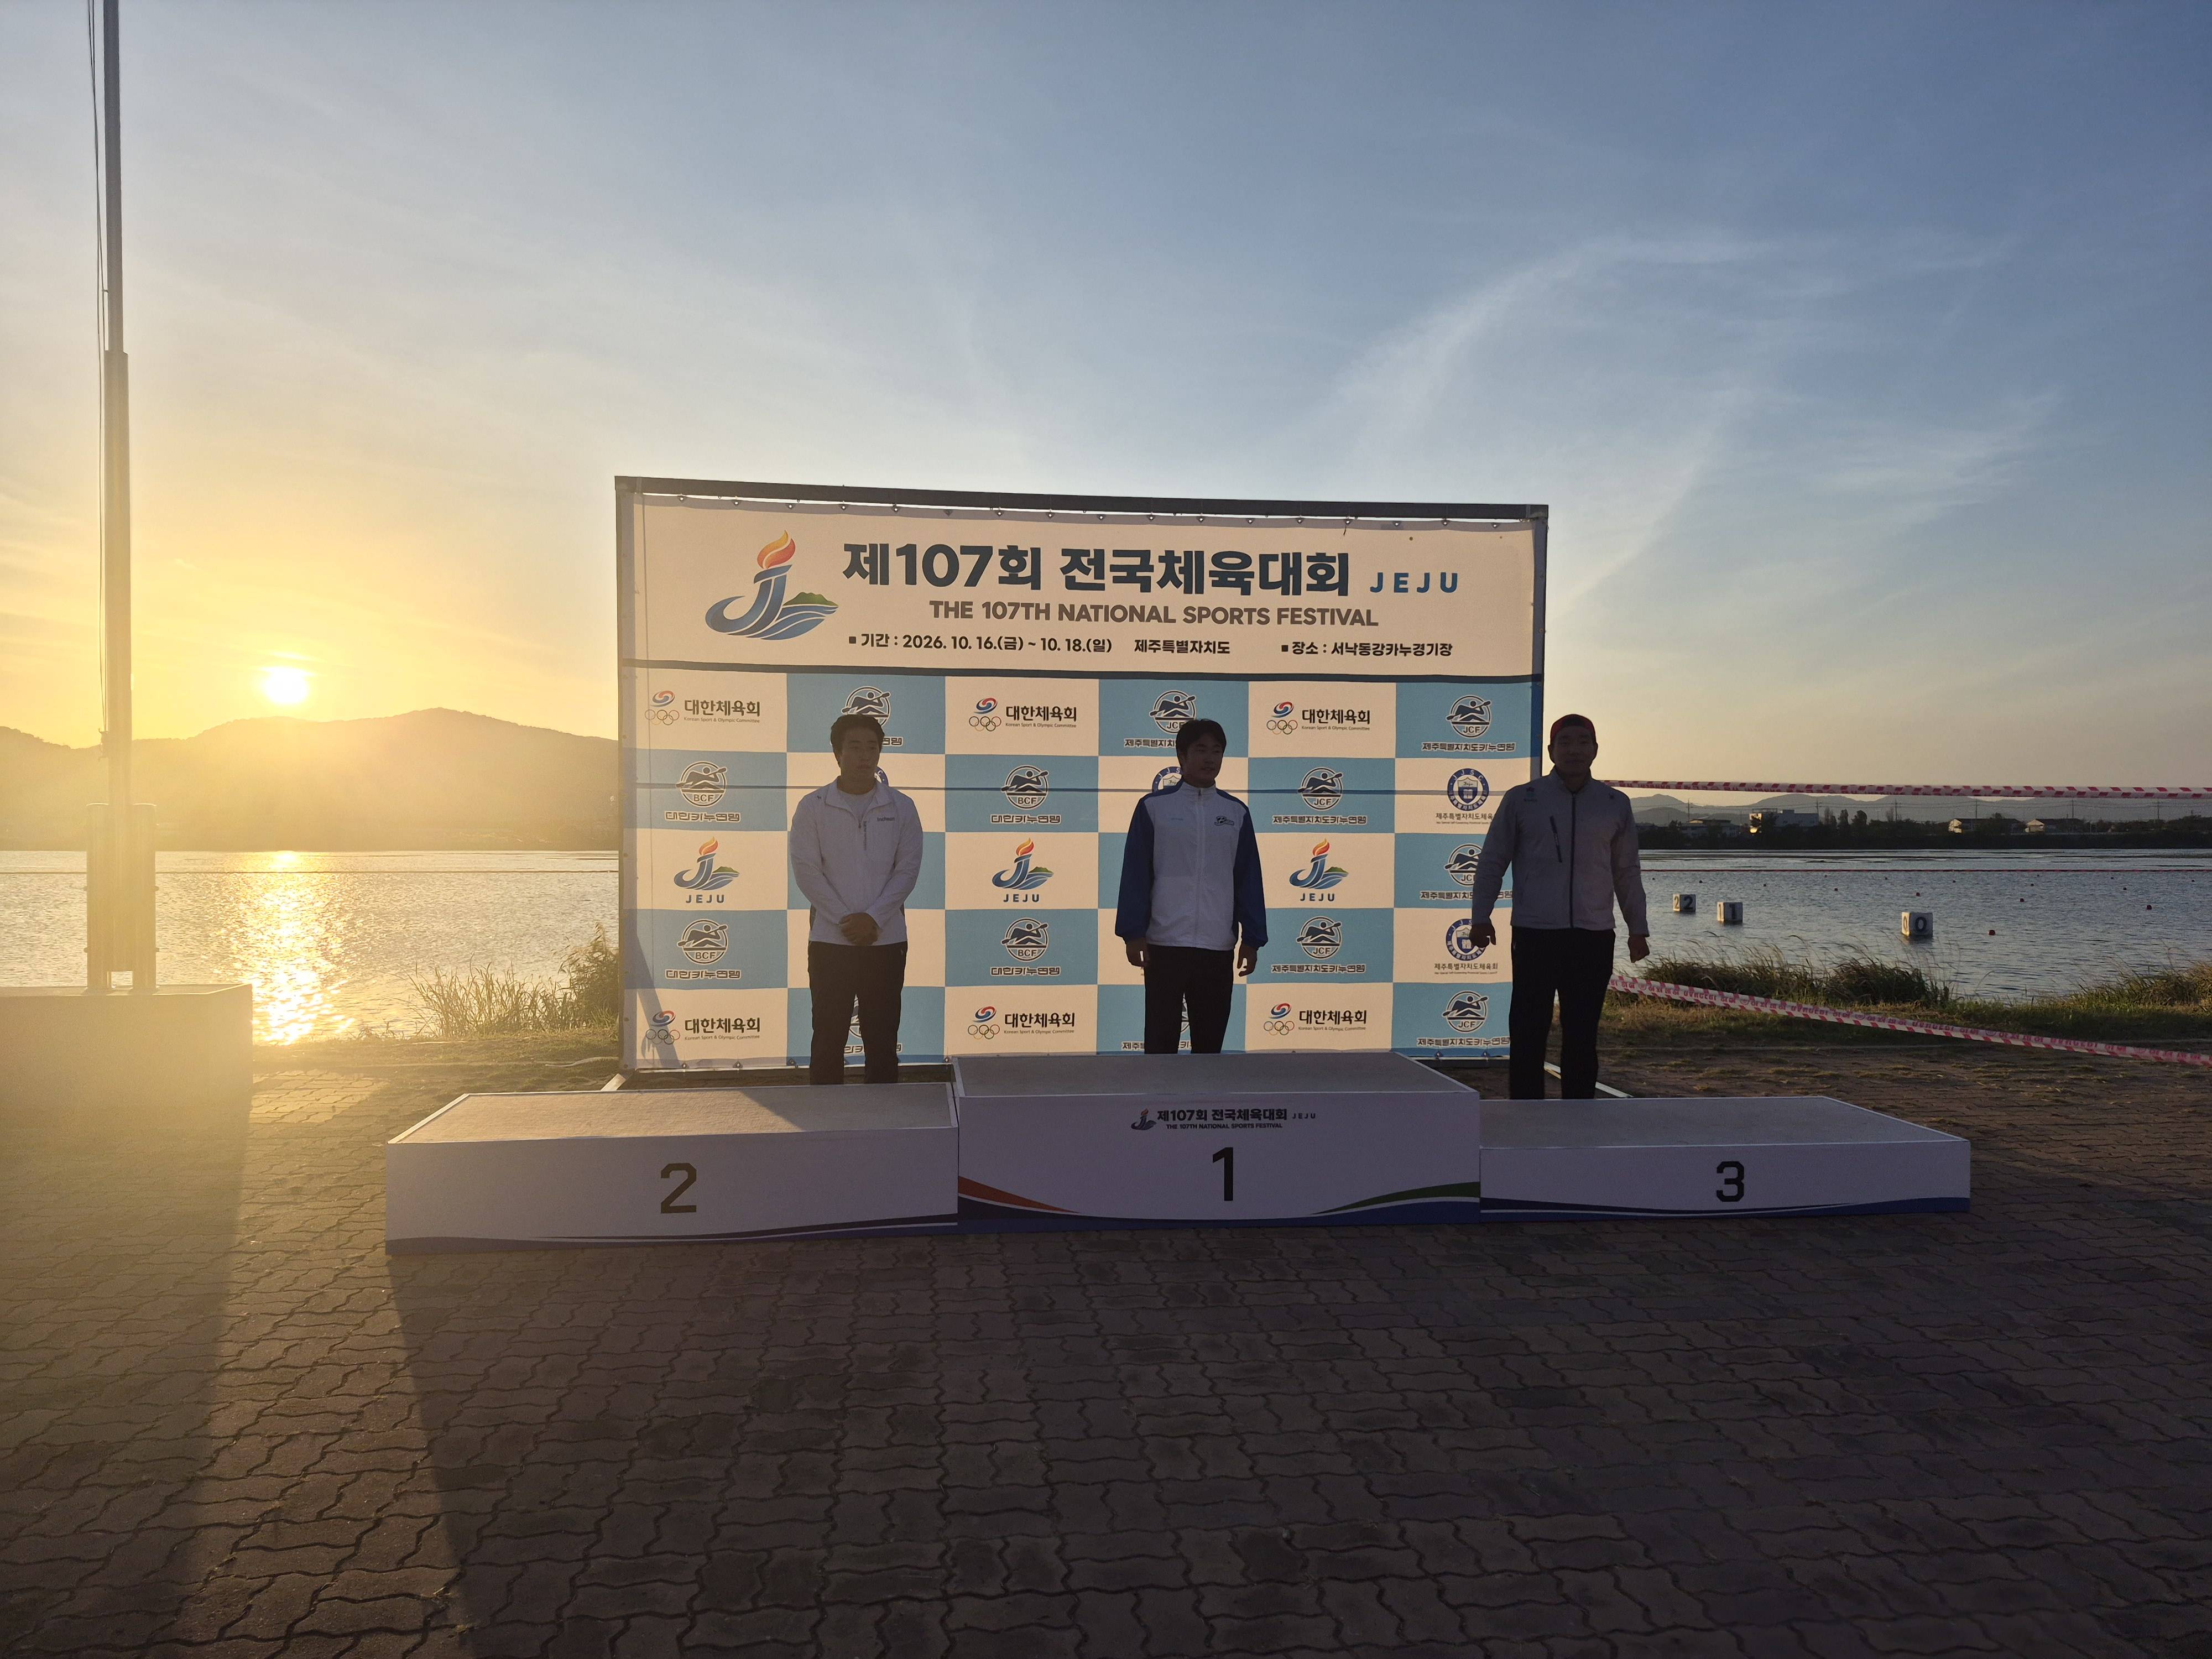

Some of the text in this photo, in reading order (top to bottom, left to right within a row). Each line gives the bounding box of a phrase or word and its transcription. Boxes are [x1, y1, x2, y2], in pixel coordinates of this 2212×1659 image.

[843, 544, 1457, 596] 제107회 전국체육대회 JEJU
[930, 601, 1378, 626] THE 107TH NATIONAL SPORTS FESTIVAL
[862, 634, 889, 647] 기간
[903, 635, 946, 649] 2026.
[952, 637, 972, 649] 10.
[977, 637, 1023, 650] 16.(금)
[1041, 638, 1060, 651] 10.
[1066, 639, 1112, 653] 18.(일)
[1135, 640, 1230, 654] 제주특별자치도
[1292, 642, 1318, 654] 장소
[1332, 643, 1452, 656] 서낙동강카누경기장
[684, 700, 760, 717] 대한체육회
[1006, 706, 1077, 722] 대한체육회
[1302, 709, 1370, 724] 대한체육회
[666, 812, 740, 822] 대한카누연맹
[991, 815, 1061, 823] 대한카누연맹
[686, 895, 724, 903] JEJU
[1300, 893, 1334, 901] JEJU
[1683, 896, 1693, 910] 2
[1729, 904, 1736, 920] 1
[666, 969, 740, 979] 대한카누연맹
[991, 967, 1060, 975] 대한카누연맹
[1005, 1013, 1075, 1028] 대한체육회
[1299, 1010, 1367, 1025] 대한체육회
[685, 1017, 760, 1034] 대한체육회
[1157, 1109, 1207, 1121] 제107회
[1212, 1109, 1287, 1121] 전국체육대회
[1213, 1147, 1233, 1201] 1
[1717, 1161, 1744, 1202] 3
[661, 1163, 697, 1213] 2
